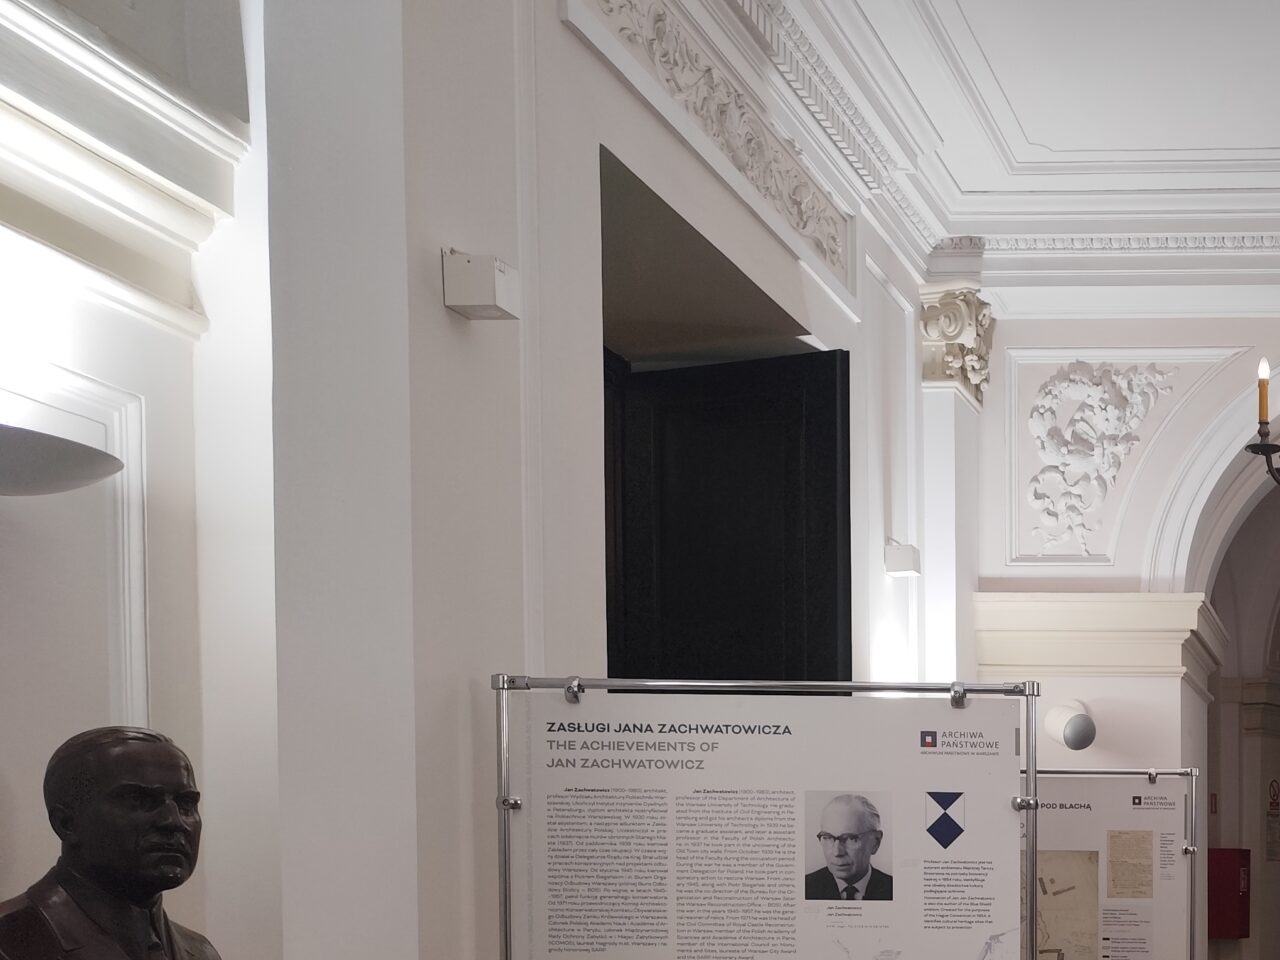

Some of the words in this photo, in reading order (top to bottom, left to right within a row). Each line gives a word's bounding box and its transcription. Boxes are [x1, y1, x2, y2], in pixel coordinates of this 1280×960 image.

[546, 722, 610, 733] ZASŁUGI
[614, 723, 654, 733] JANA
[657, 724, 792, 735] ZACHWATOWICZA
[546, 740, 577, 750] THE
[580, 740, 696, 752] ACHIEVEMENTS
[700, 742, 719, 752] OF
[941, 740, 1000, 749] PAŃSTWOWE
[546, 758, 576, 768] JAN
[580, 758, 704, 770] ZACHWATOWICZ
